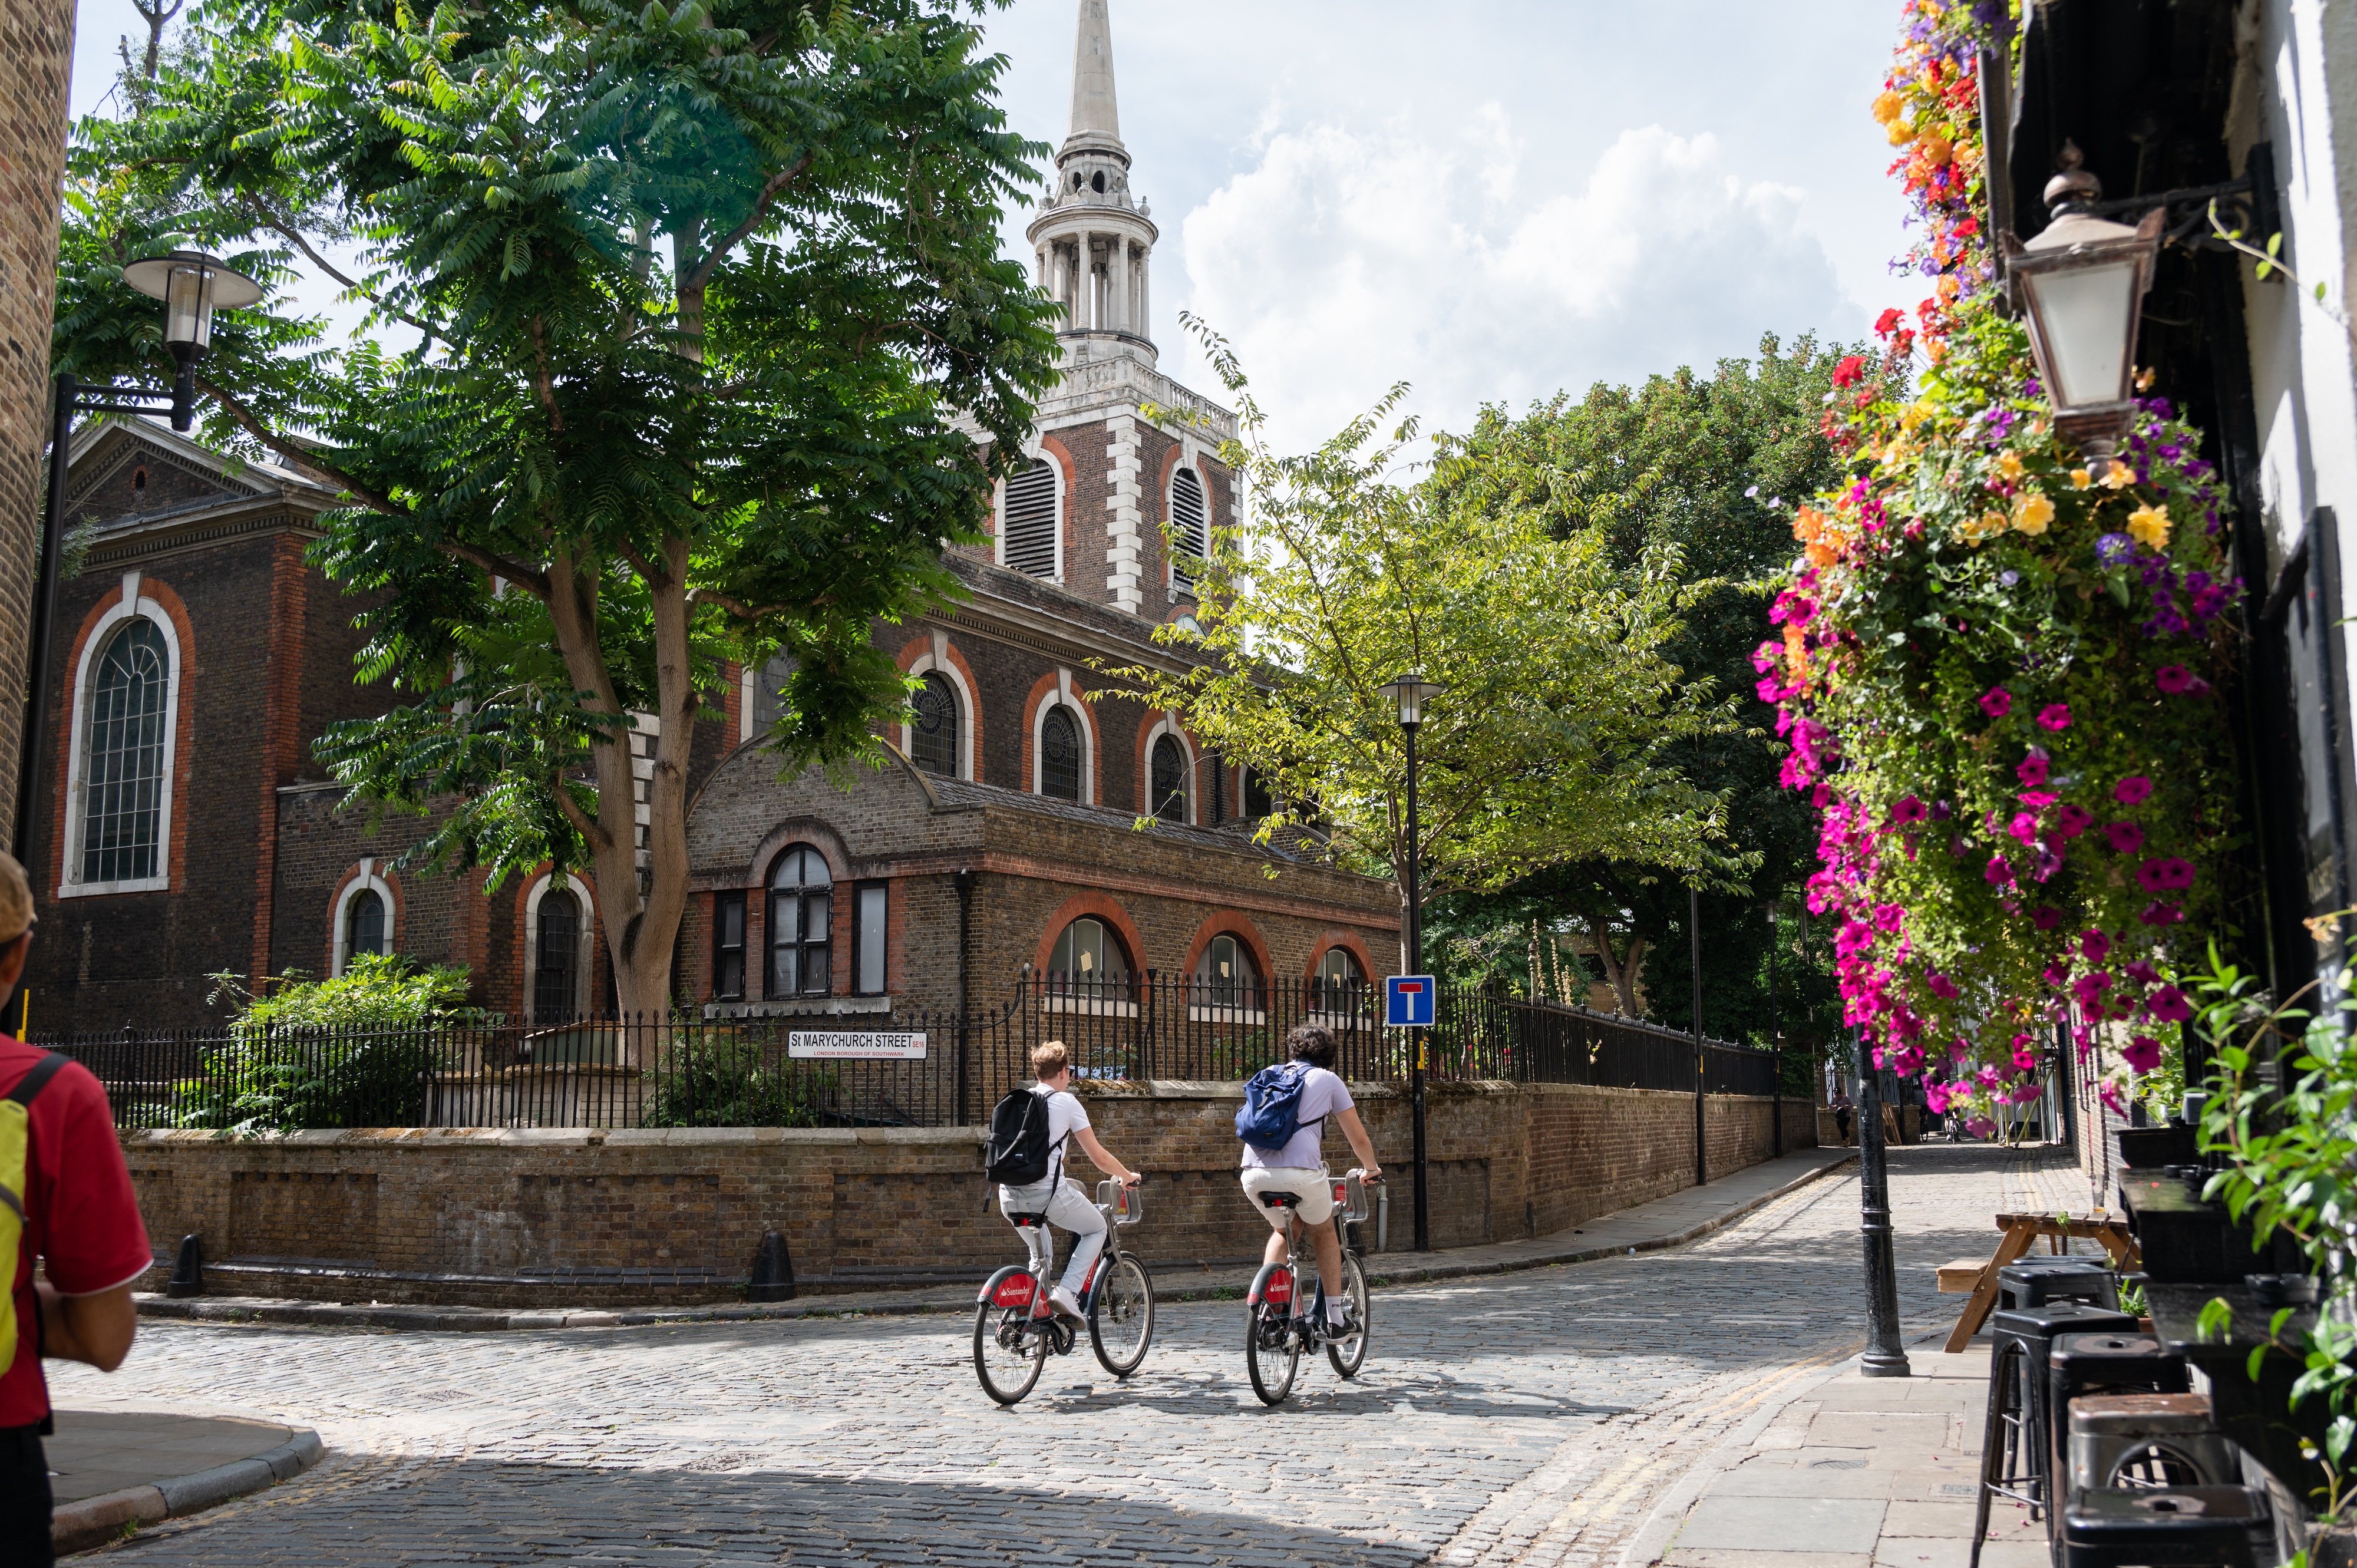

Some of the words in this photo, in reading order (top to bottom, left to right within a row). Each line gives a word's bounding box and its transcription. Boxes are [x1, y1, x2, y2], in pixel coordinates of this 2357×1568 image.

[791, 1034, 801, 1047] St
[804, 1034, 873, 1047] MARYCHURCH
[876, 1035, 913, 1048] STREET
[1006, 1286, 1030, 1296] Santander
[1274, 1282, 1290, 1292] Santander
